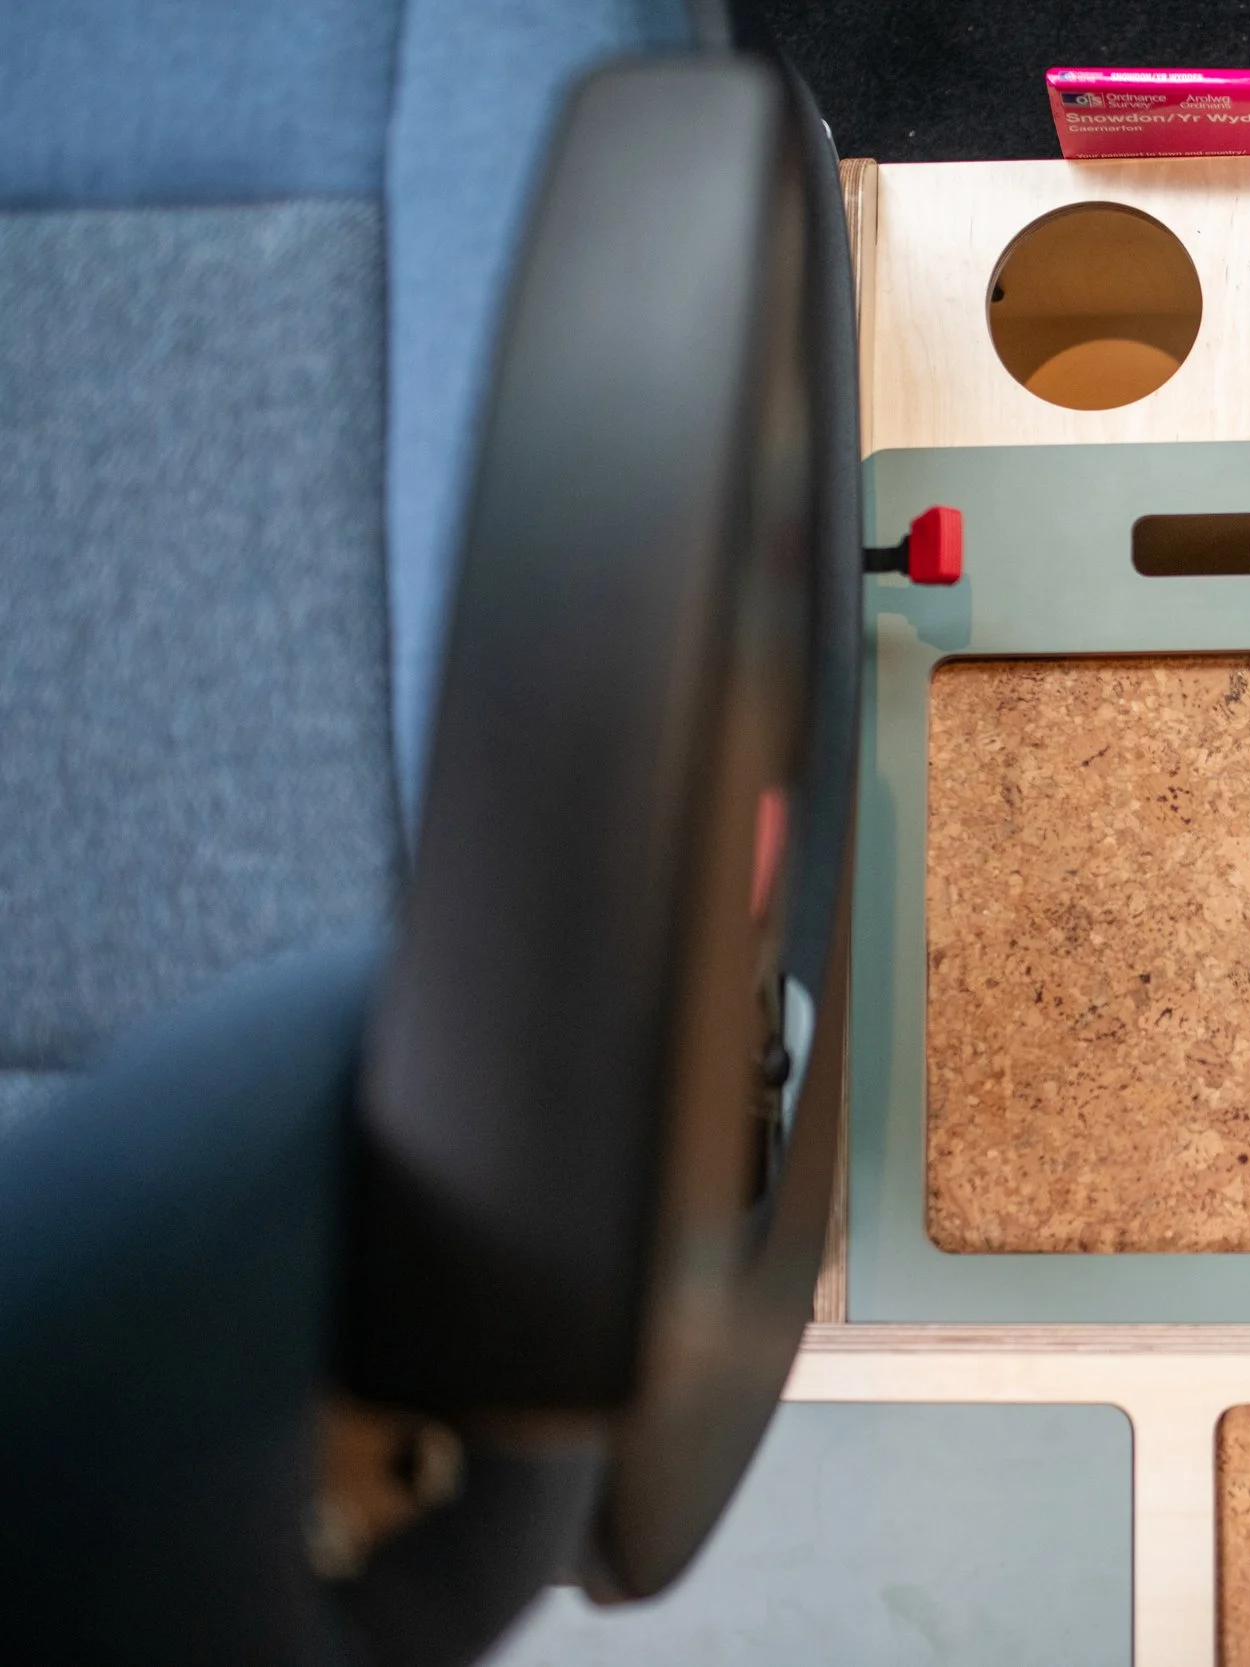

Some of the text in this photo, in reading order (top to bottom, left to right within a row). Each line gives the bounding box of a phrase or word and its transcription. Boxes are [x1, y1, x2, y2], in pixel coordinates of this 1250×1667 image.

[1106, 93, 1167, 103] Ordnance
[1108, 101, 1151, 110] Survey
[1066, 112, 1201, 124] Snowdon/Yr
[1068, 125, 1143, 133] Caernarfon
